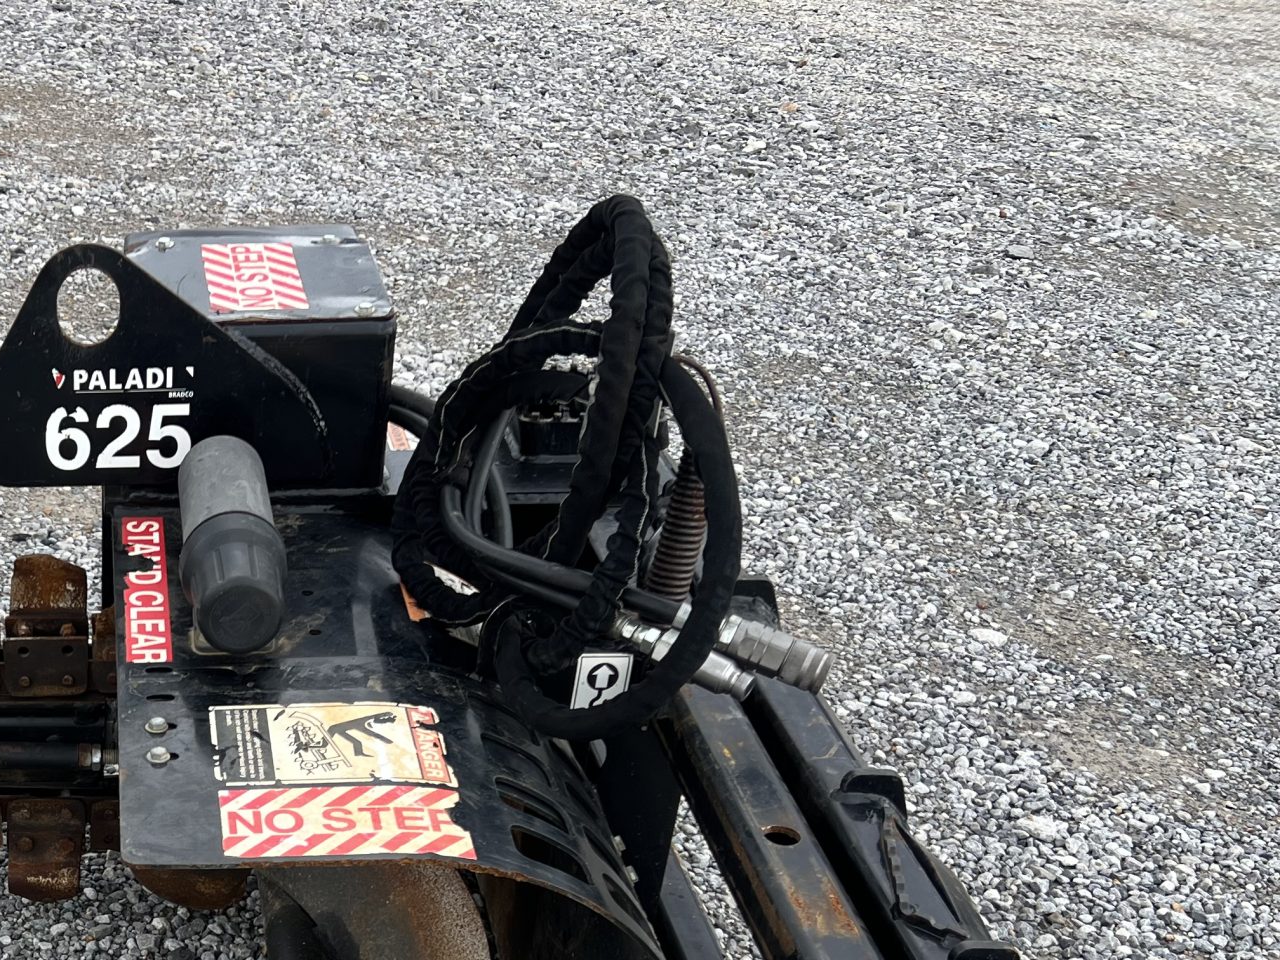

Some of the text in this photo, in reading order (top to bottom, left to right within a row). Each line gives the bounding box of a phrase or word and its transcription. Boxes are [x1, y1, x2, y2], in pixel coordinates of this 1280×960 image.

[230, 245, 276, 308] NO STEP
[73, 366, 194, 391] PALADI
[45, 403, 192, 471] 625
[128, 590, 168, 664] CLEAR
[227, 809, 304, 835] NO
